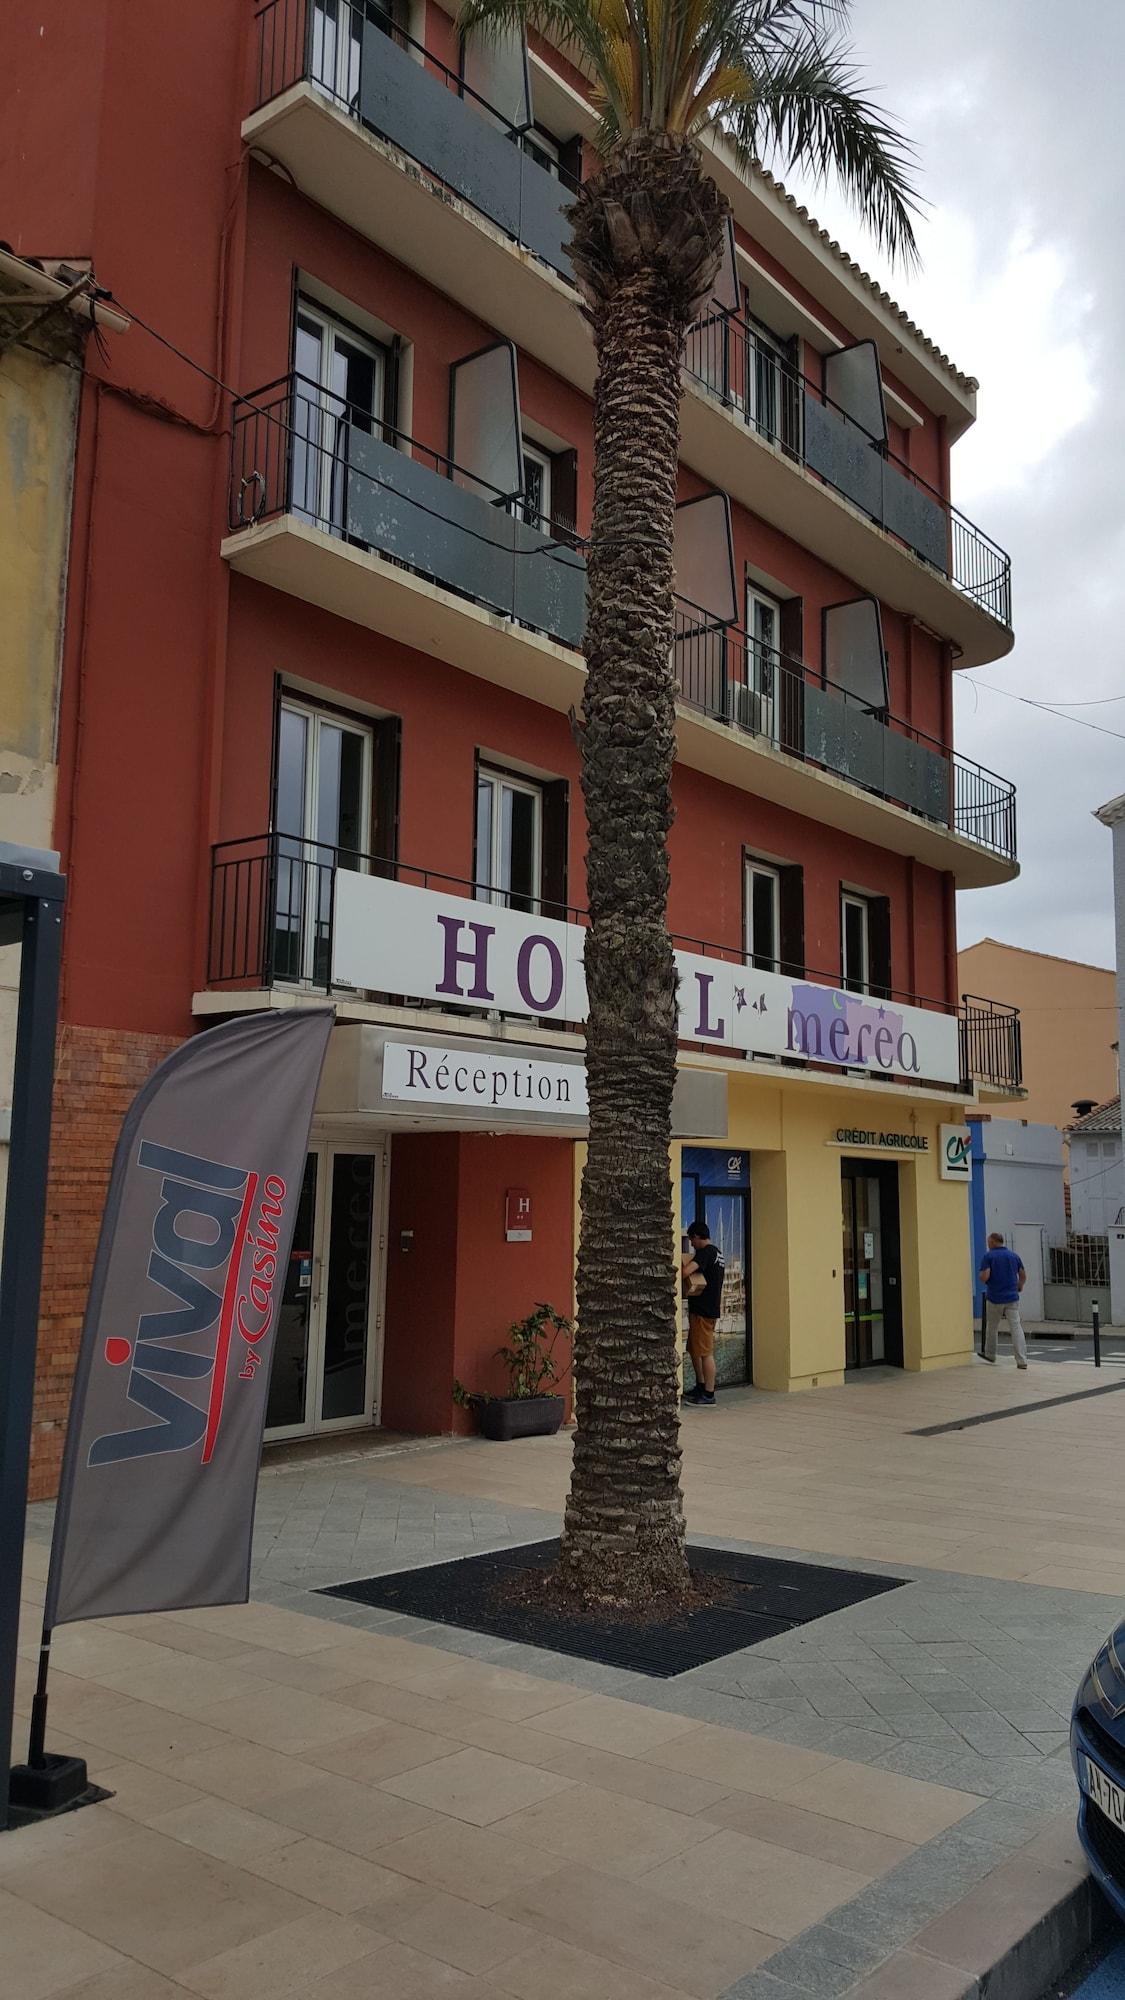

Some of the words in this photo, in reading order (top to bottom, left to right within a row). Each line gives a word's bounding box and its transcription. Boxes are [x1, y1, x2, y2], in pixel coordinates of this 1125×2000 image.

[435, 914, 724, 1039] HOL
[405, 1049, 571, 1105] Réception
[836, 1127, 876, 1144] CRÉDIT
[879, 1132, 928, 1150] AGRICOLE
[519, 1198, 530, 1213] H
[237, 1174, 287, 1345] Casino
[239, 1348, 262, 1380] by
